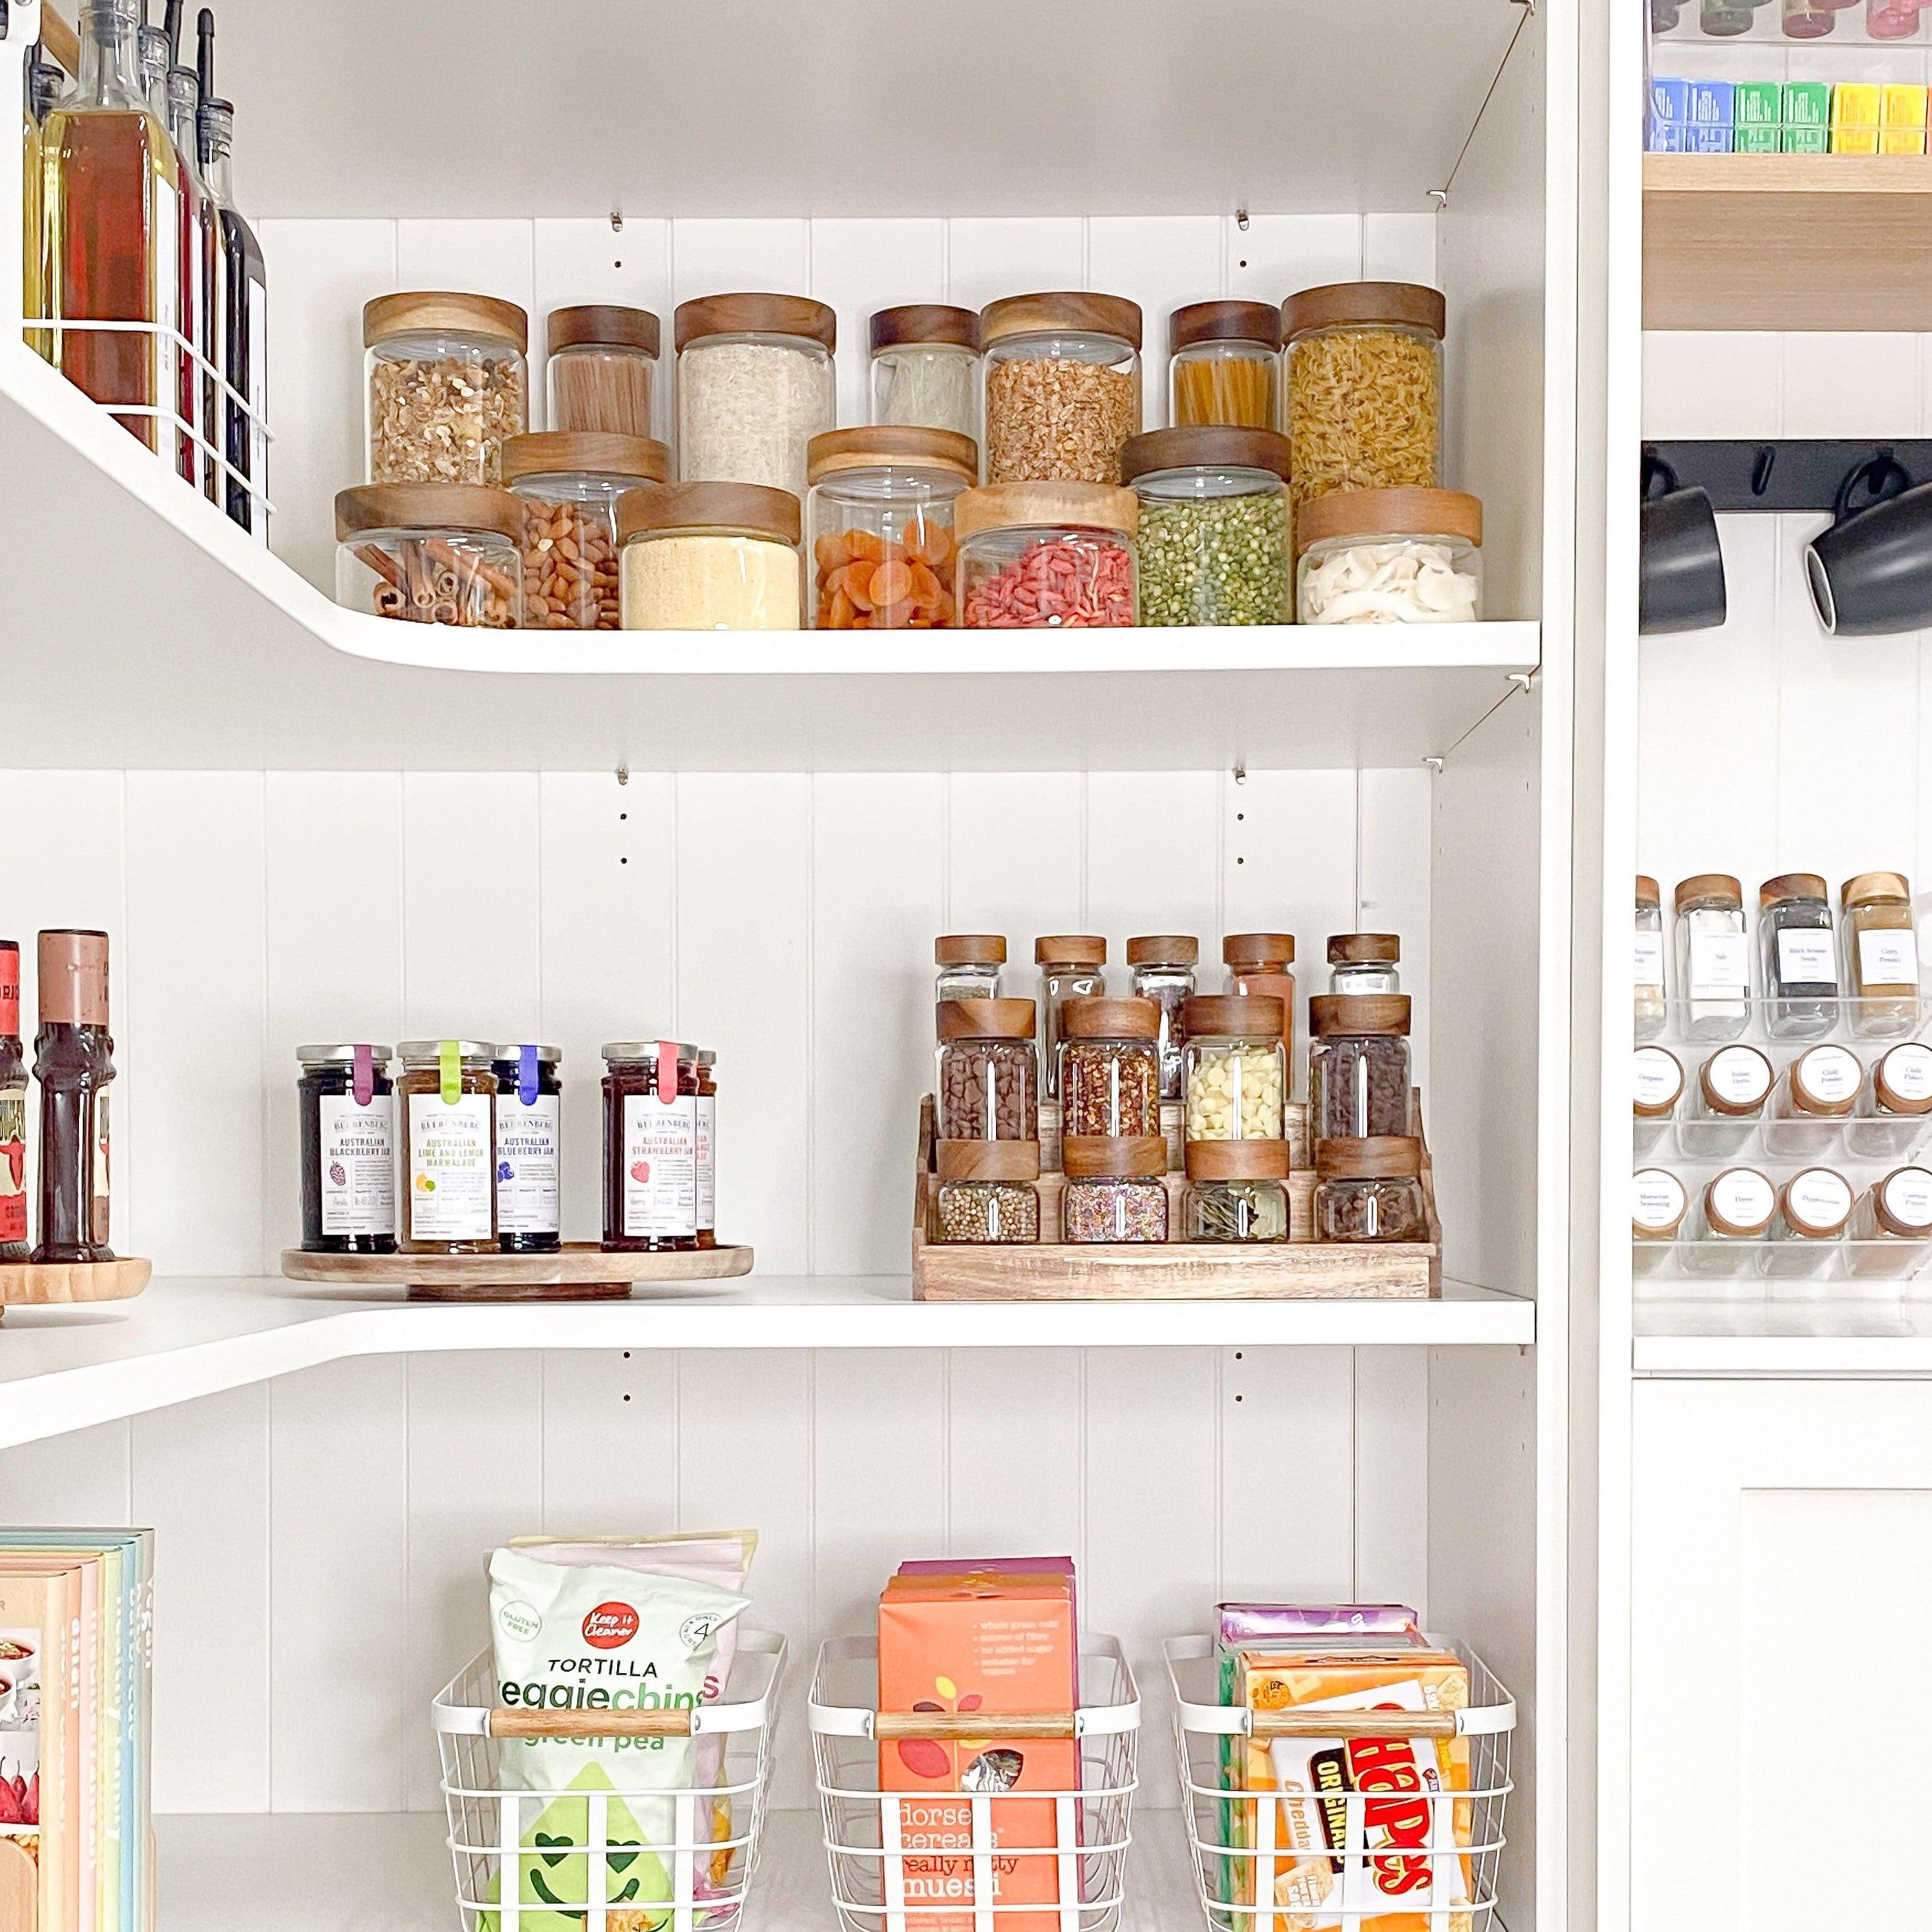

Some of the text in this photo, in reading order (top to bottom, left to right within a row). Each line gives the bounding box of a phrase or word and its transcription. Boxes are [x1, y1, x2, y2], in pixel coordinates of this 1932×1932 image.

[340, 1138, 385, 1147] AUSTRALIAN
[427, 1139, 477, 1147] AUSTRALIAN
[504, 1138, 550, 1146] AUSTRALIAN
[642, 1137, 687, 1145] AUSTRALIAN
[497, 1147, 542, 1156] BLUEBERRY
[504, 1611, 539, 1628] GLUTEN
[590, 1611, 620, 1627] Keep
[507, 1621, 529, 1635] FREE
[584, 1625, 633, 1637] Cleaner
[693, 1623, 708, 1640] 4
[549, 1659, 658, 1678] TORTILLA
[900, 1803, 972, 1826] dorse
[1284, 1779, 1311, 1850] Chedda
[901, 1832, 999, 1849] cereas
[904, 1856, 957, 1876] eally
[903, 1871, 1003, 1898] muesi
